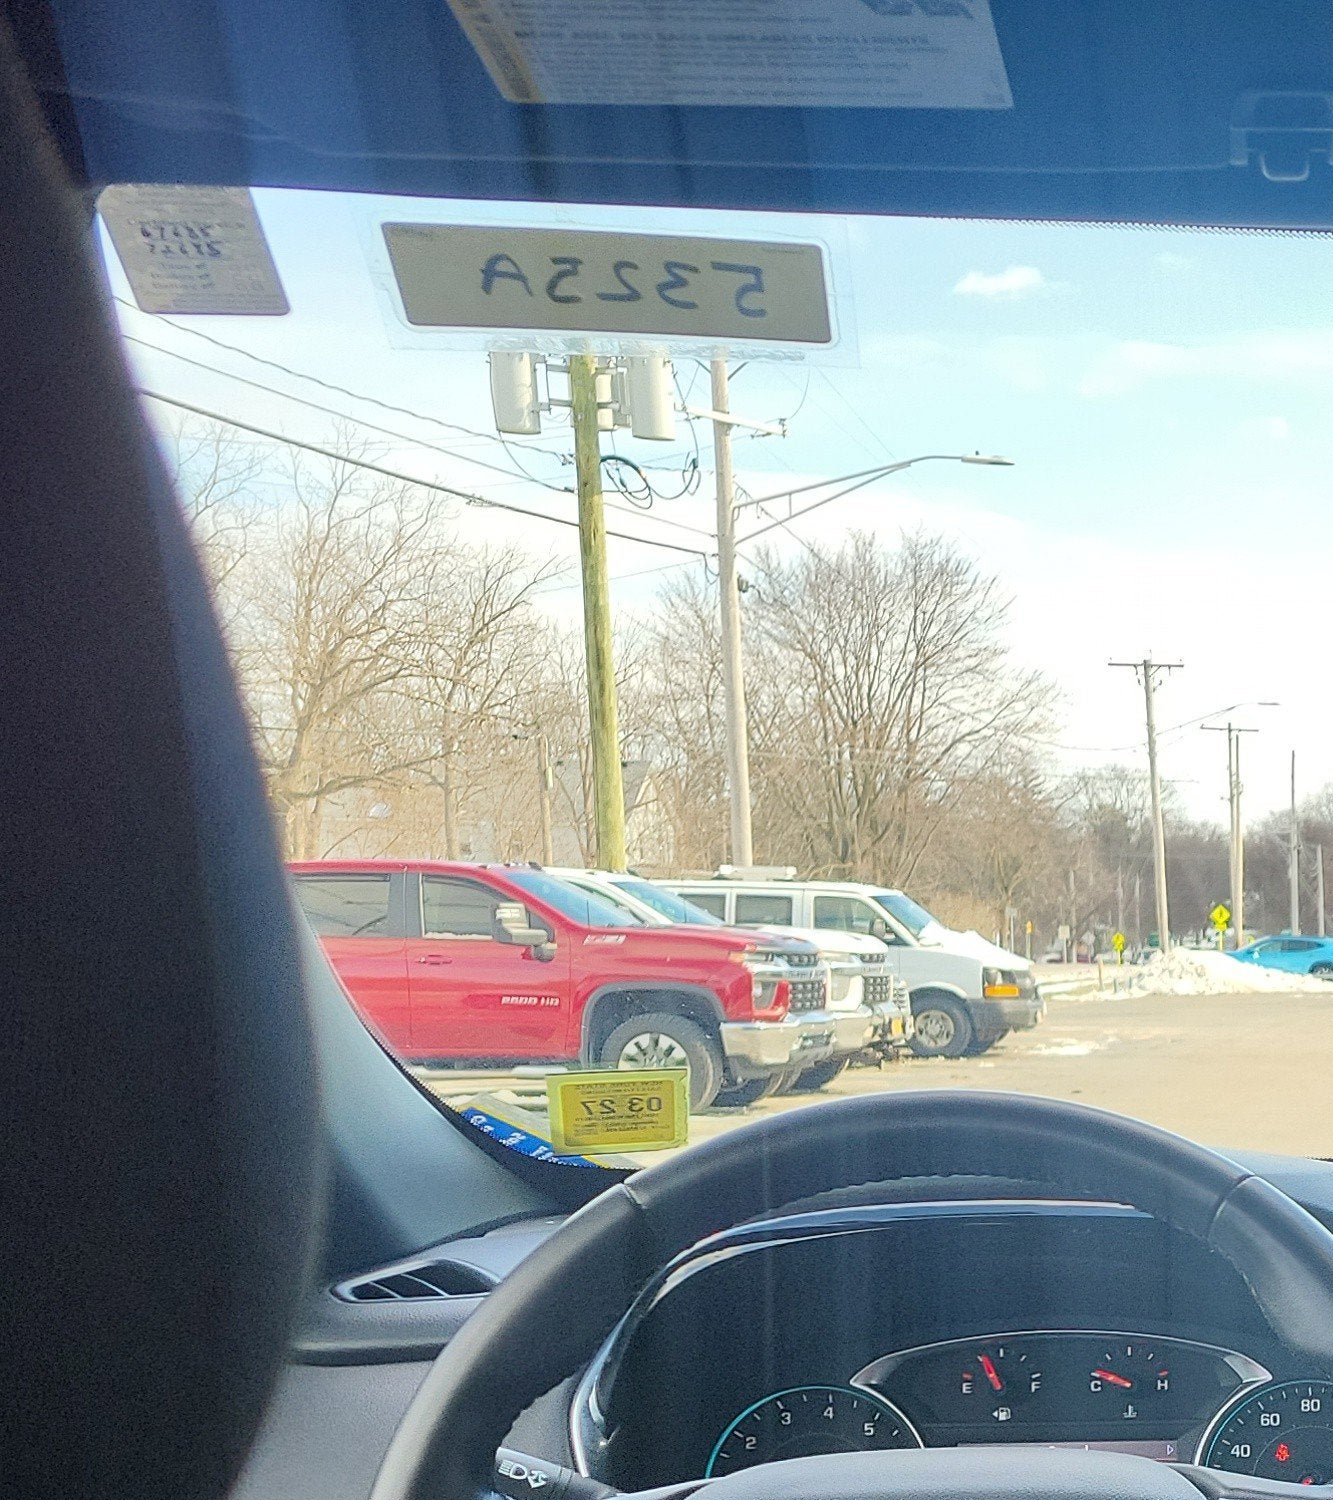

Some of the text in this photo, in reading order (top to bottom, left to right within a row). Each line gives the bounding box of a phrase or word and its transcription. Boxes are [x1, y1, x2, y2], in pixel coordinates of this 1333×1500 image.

[962, 1382, 973, 1394] E
[1031, 1381, 1041, 1393] F
[1090, 1380, 1102, 1392] C
[1157, 1379, 1169, 1391] H
[1300, 1398, 1320, 1412] 80
[781, 1412, 792, 1425] 3
[823, 1406, 834, 1420] 4
[1260, 1413, 1281, 1427] 60
[864, 1422, 874, 1436] 5
[745, 1436, 757, 1450] 2
[1230, 1444, 1251, 1458] 40
